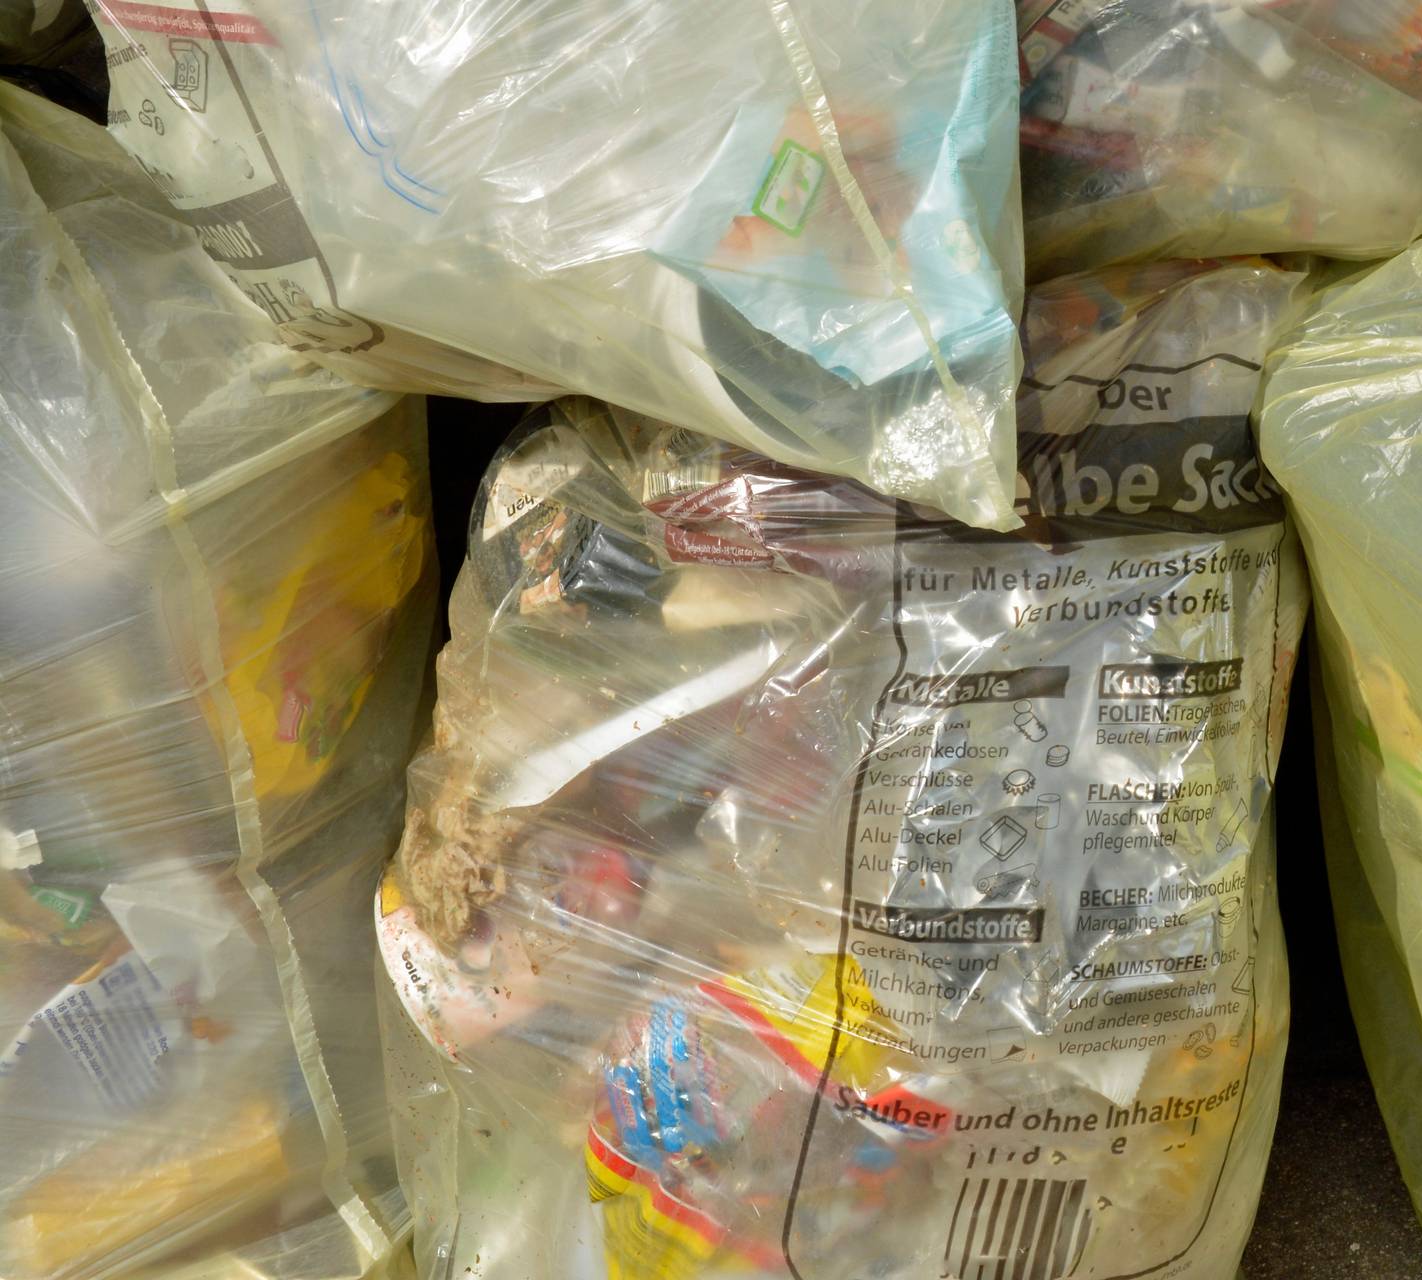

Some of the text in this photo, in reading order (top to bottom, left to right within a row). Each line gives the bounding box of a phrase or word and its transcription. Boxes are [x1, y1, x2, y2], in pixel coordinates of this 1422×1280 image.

[1098, 377, 1173, 412] Der
[1017, 446, 1160, 518] lbe
[904, 565, 955, 593] für
[1106, 546, 1252, 581] Kunststoffe
[899, 677, 1011, 702] Metalle
[1098, 704, 1171, 724] FOLIEN:
[1096, 728, 1151, 746] Beutel,
[876, 744, 1010, 763] Getränkedosen
[868, 769, 975, 789] Verschlüsse
[1087, 782, 1186, 803] FLASCHEN:
[1188, 781, 1213, 798] Von
[863, 799, 974, 817] Alu-Schalen
[859, 826, 963, 846] Alu-Deckel
[1082, 830, 1178, 855] pflegemittel
[857, 854, 954, 874] Alu-Folien
[1078, 887, 1154, 908] BECHER:
[858, 906, 1034, 941] Verbundstoffe
[1163, 912, 1189, 929] etc.
[850, 939, 1001, 973] Getränke- und
[1070, 954, 1209, 982] SCHAUMSTOFFE:
[847, 966, 986, 1005] Milchkartons,
[1068, 981, 1218, 1011] und Gemüseschalen
[1063, 1000, 1241, 1035] und andere geschäumte
[1057, 1032, 1167, 1057] Verpackungen
[834, 1076, 1242, 1132] Sauber und ohne Inhaltsreste
